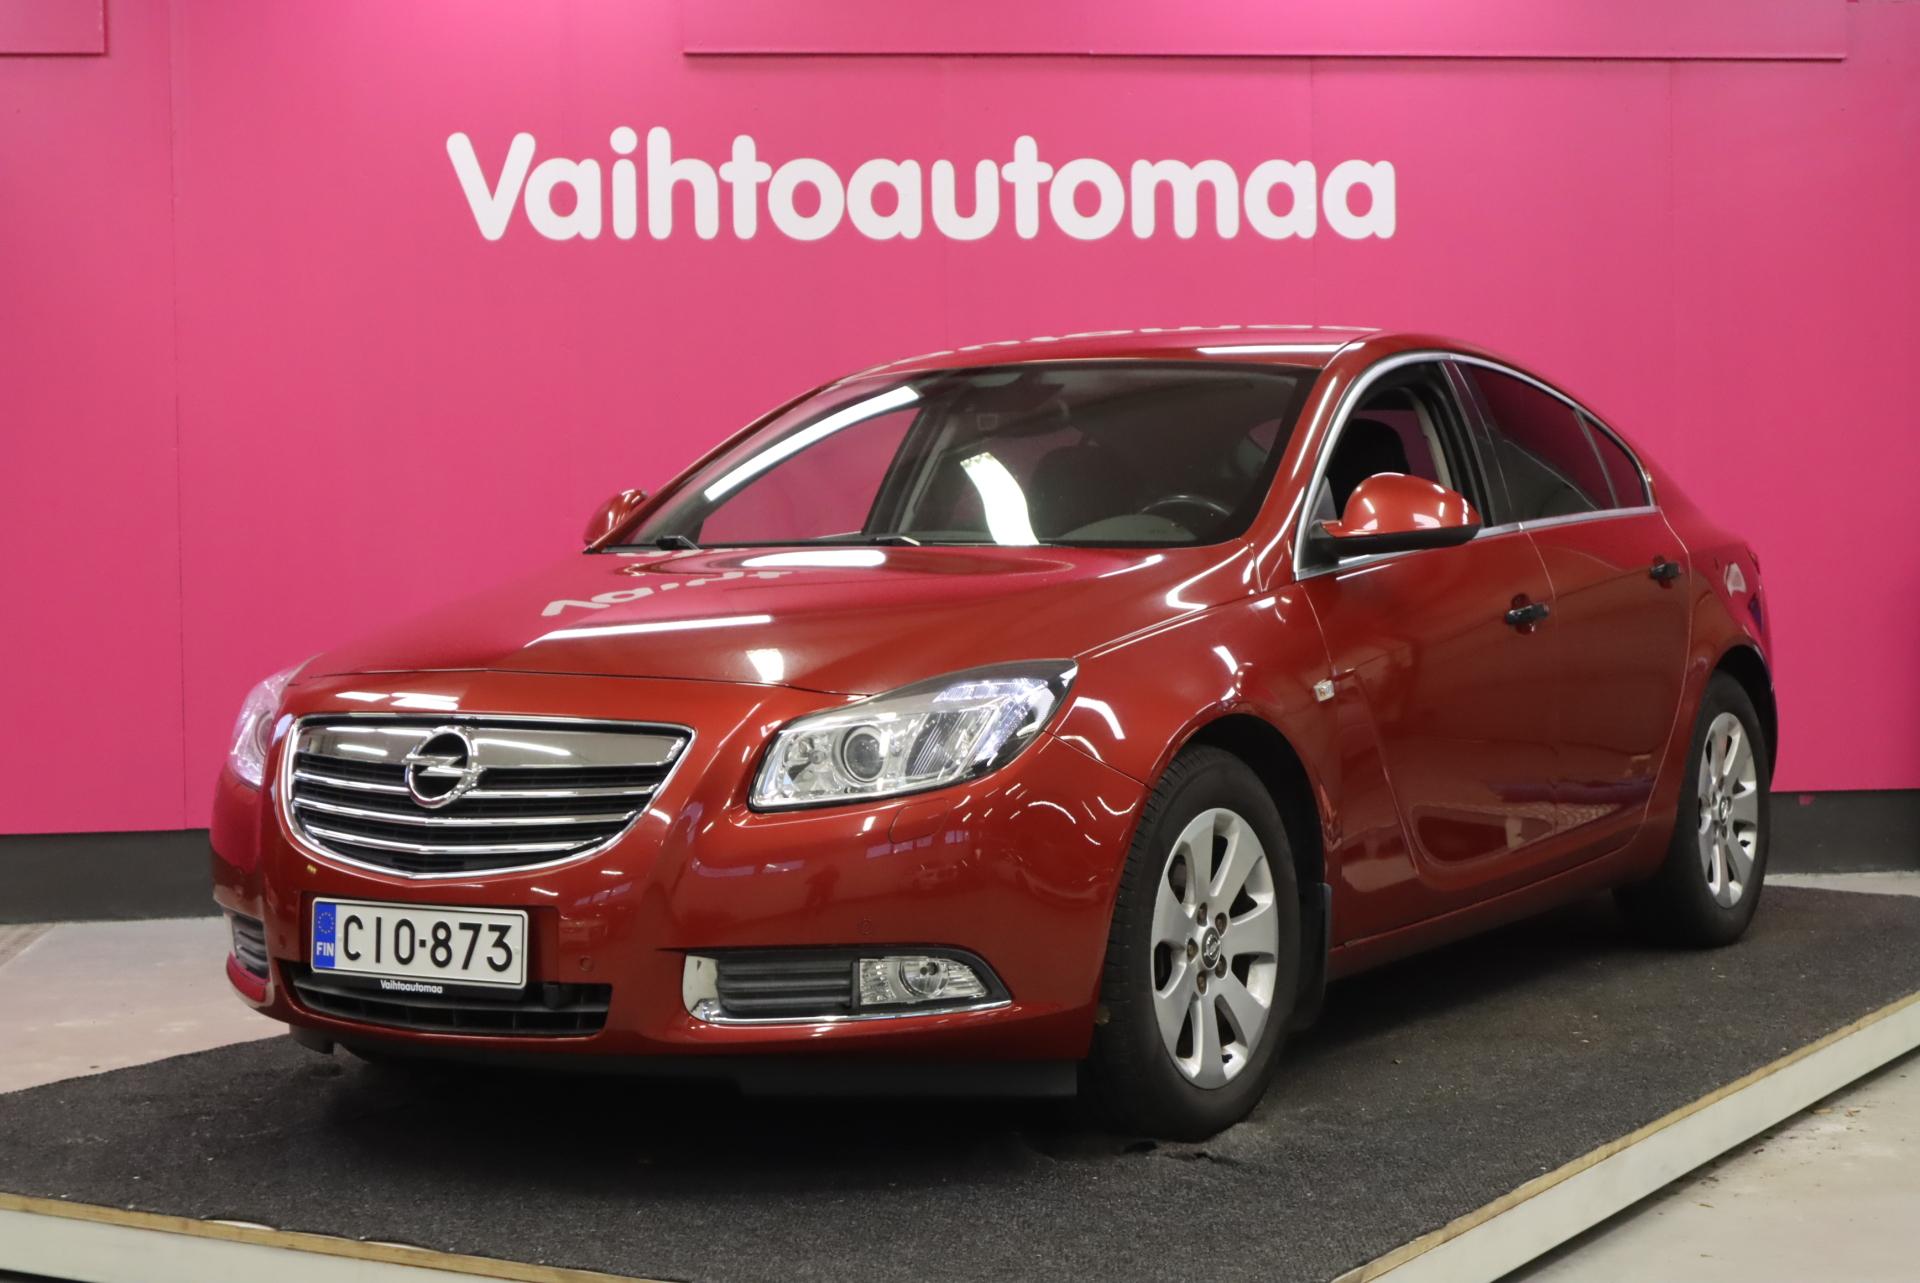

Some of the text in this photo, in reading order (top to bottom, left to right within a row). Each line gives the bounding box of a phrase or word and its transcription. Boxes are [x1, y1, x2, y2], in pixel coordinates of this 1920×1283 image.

[446, 126, 1396, 241] Vaihtoautomaa
[316, 941, 335, 957] FIN
[343, 914, 513, 972] CIO-873
[380, 979, 443, 994] Vaihtoautomaa
